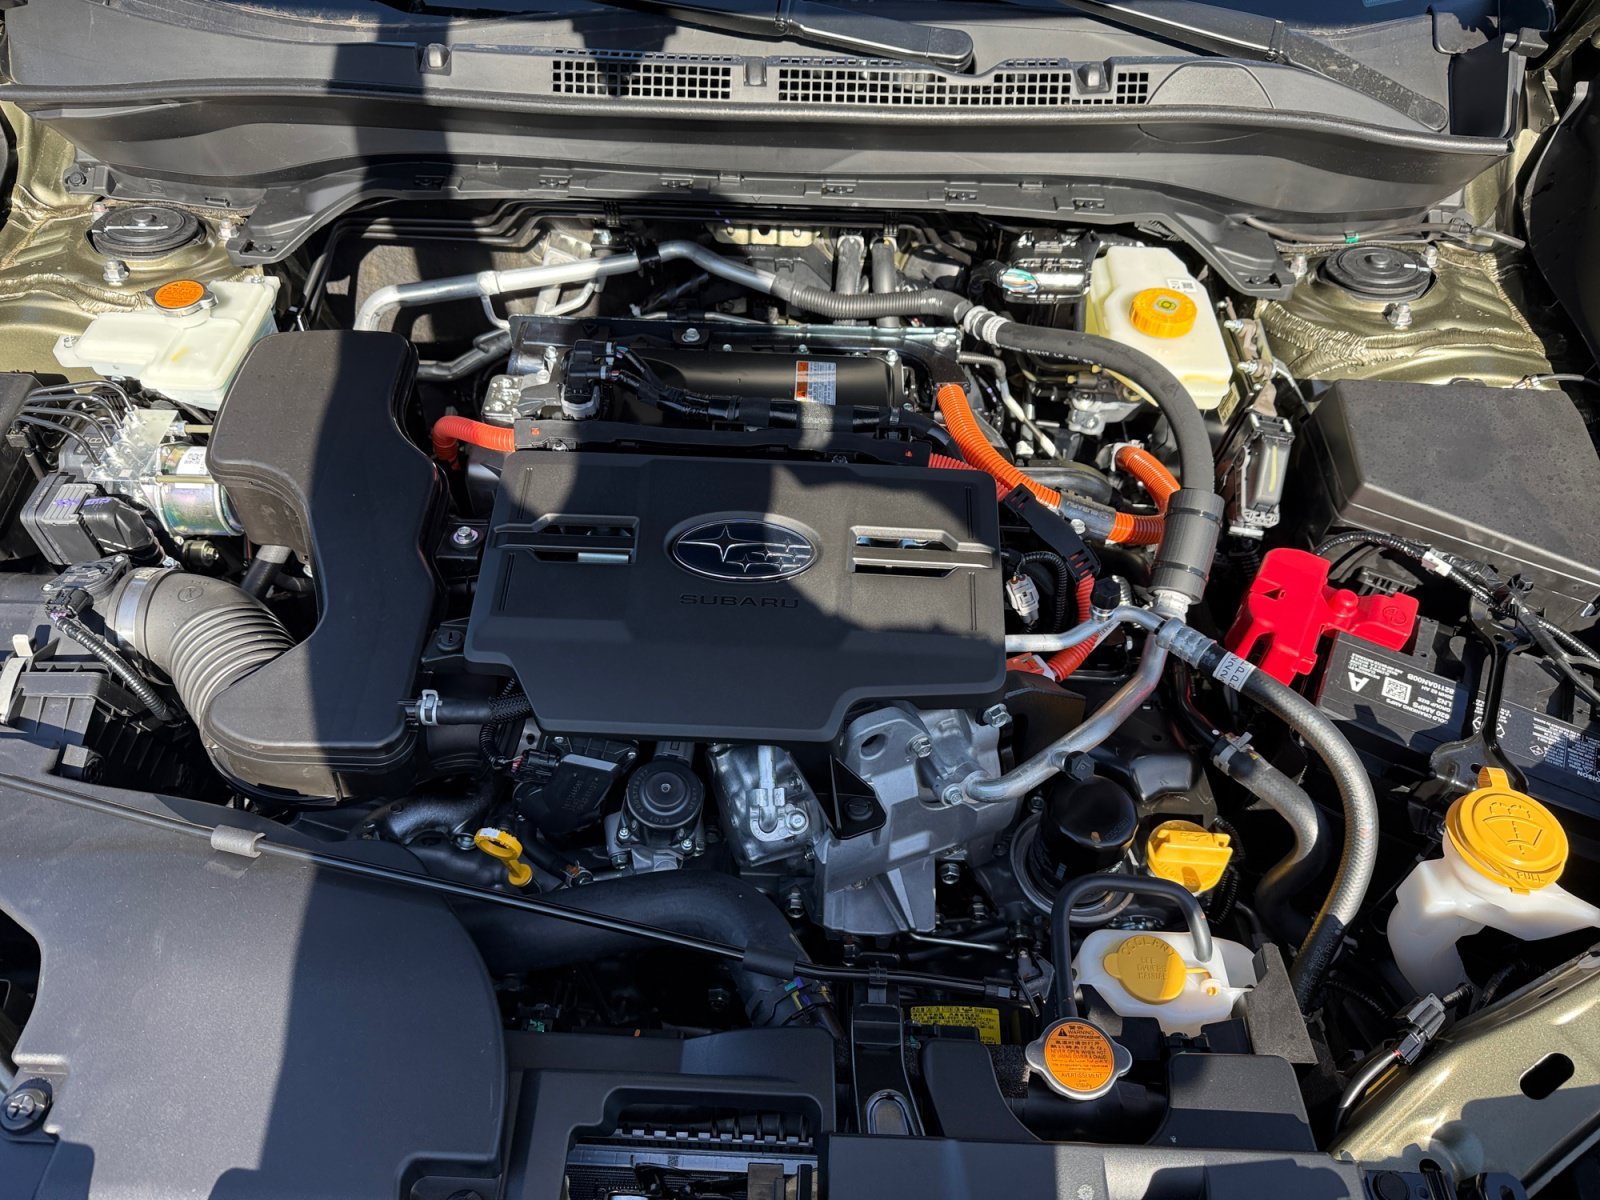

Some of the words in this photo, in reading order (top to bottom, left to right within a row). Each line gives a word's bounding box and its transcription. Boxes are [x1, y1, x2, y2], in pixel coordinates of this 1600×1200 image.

[680, 594, 799, 609] SUBARU
[1347, 670, 1369, 692] A
[1385, 697, 1402, 708] AMPS
[1411, 700, 1435, 714] AMPS
[1429, 701, 1451, 712] GROUP
[1401, 703, 1432, 719] CRANKING
[1431, 714, 1448, 724] COLD
[1517, 871, 1545, 882] FULL
